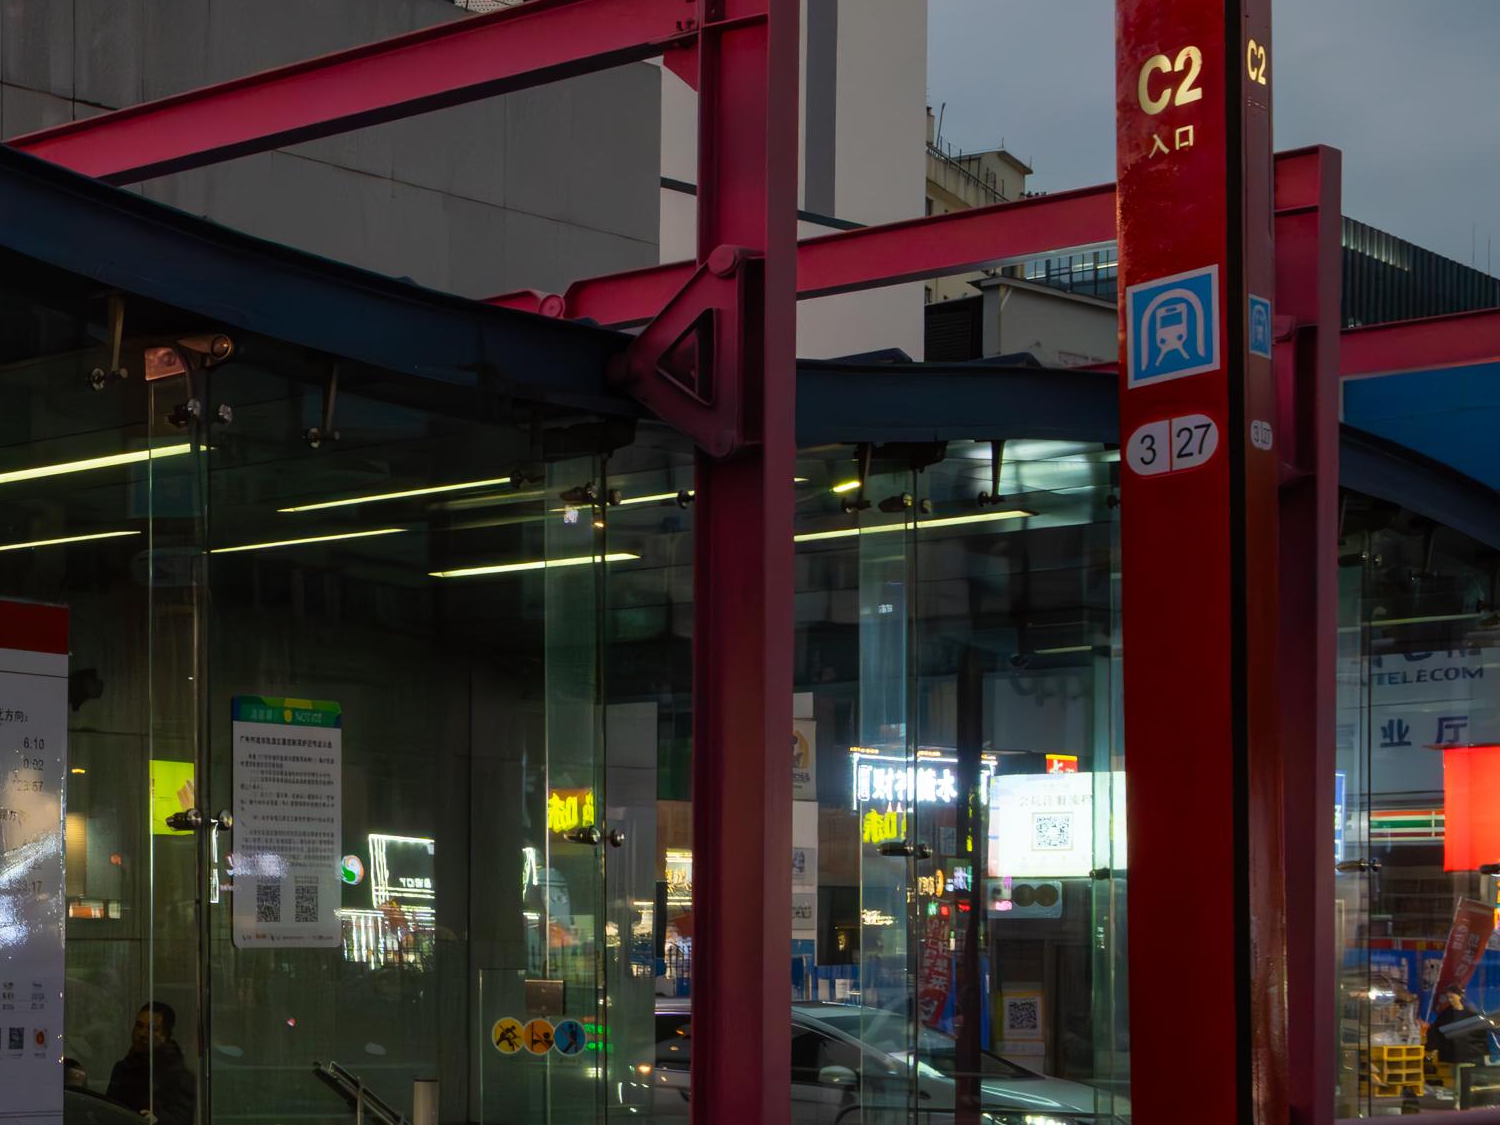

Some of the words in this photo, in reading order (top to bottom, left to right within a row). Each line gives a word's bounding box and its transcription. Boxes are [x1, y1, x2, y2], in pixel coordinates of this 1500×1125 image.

[1138, 46, 1202, 115] C2
[1247, 39, 1267, 85] C2
[1148, 124, 1194, 159] 入口
[1140, 434, 1157, 466] 3
[1176, 422, 1213, 460] 27
[1372, 666, 1484, 686] TELECOM
